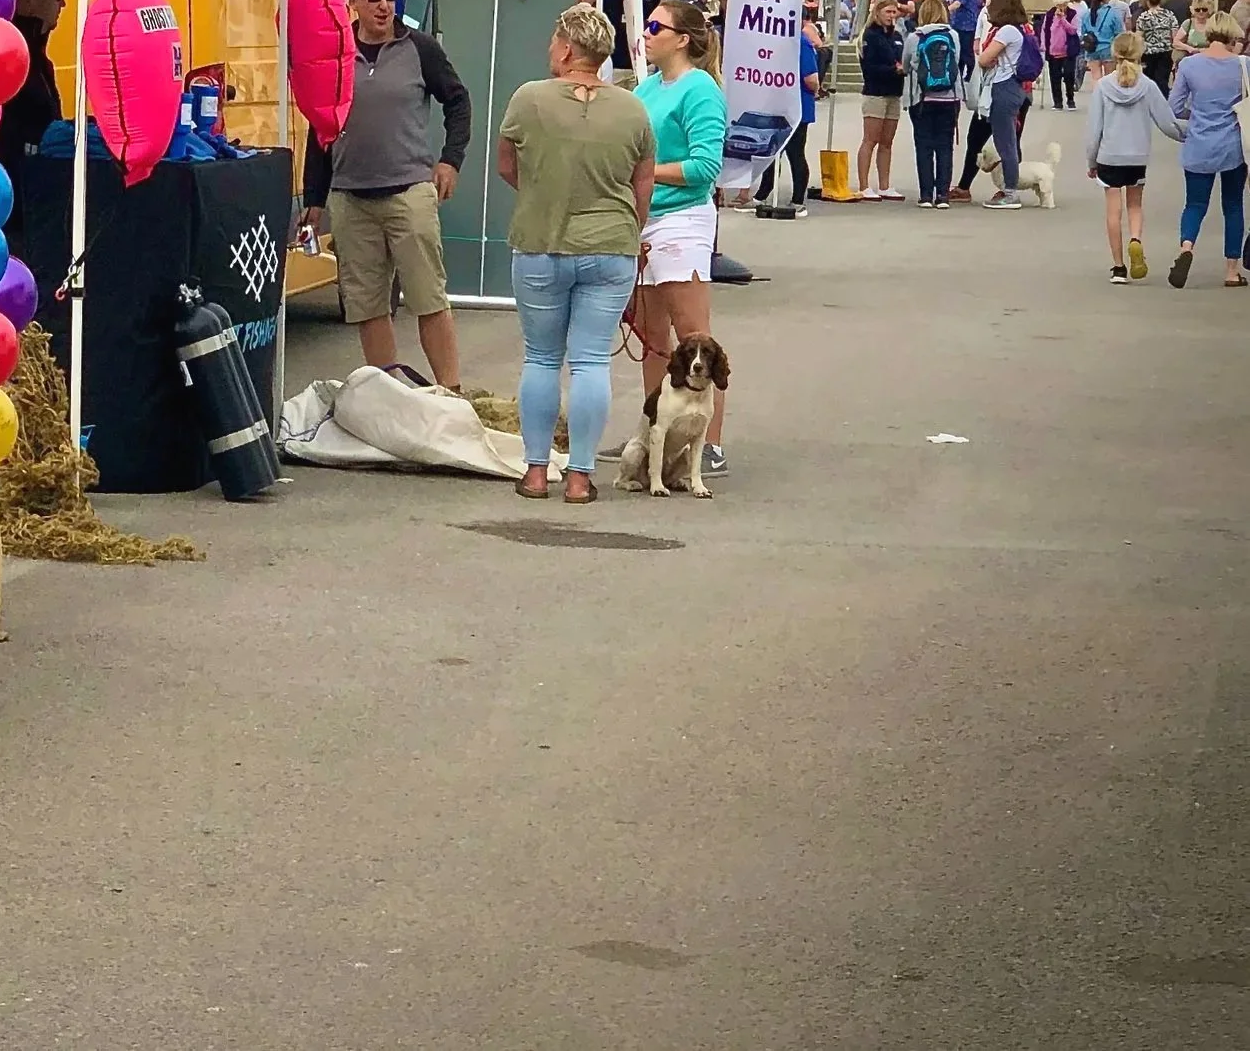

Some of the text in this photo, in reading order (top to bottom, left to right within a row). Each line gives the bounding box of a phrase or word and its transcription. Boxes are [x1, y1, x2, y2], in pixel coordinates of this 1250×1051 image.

[140, 7, 170, 31] GHOST
[738, 4, 796, 37] Mini
[758, 48, 774, 60] or
[734, 66, 795, 88] £10,000
